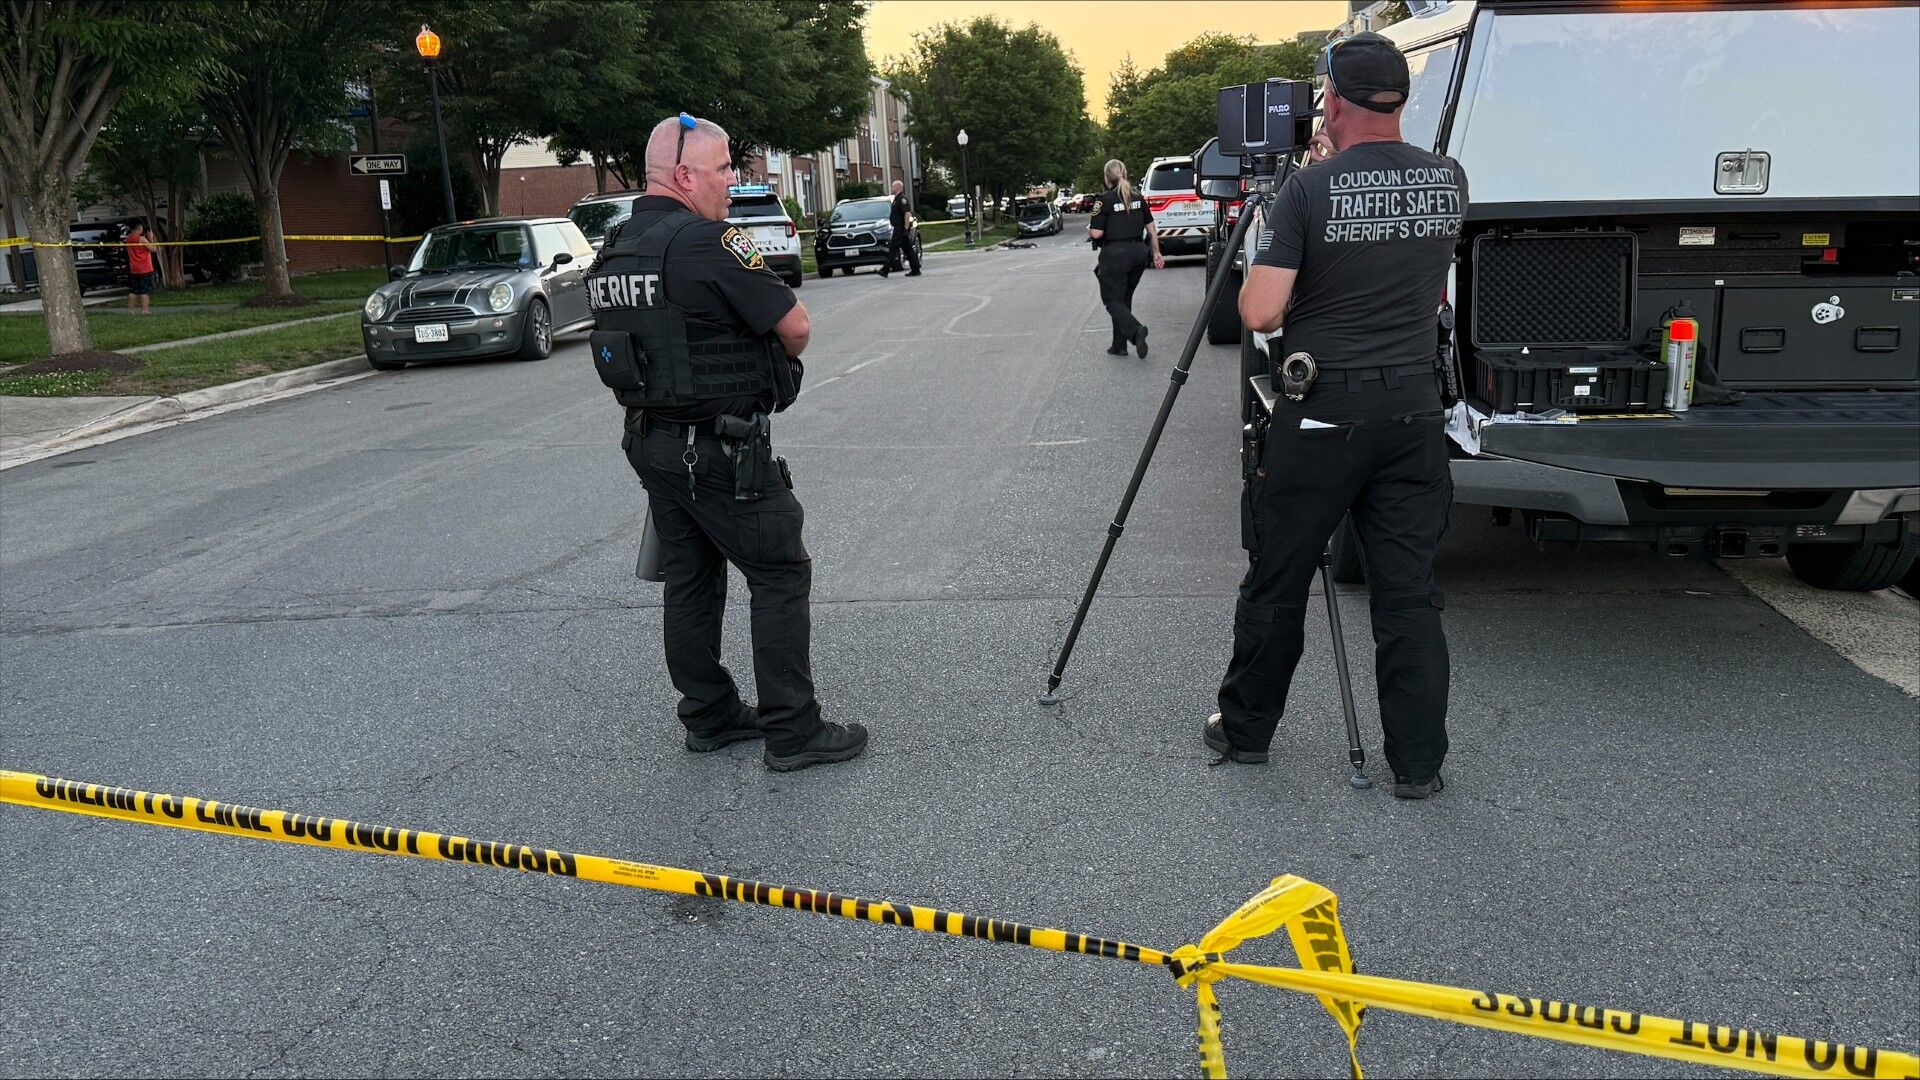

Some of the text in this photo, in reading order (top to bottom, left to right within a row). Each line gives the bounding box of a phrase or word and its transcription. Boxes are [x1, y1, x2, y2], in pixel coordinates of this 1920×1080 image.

[366, 160, 399, 169] ONE WAY
[1329, 167, 1455, 189] LOUDOUN COUNTY
[1329, 190, 1461, 218] TRAFFIC SAFETY
[1324, 218, 1462, 243] SHERIFF'S OFFICE
[587, 274, 659, 310] HERIFF
